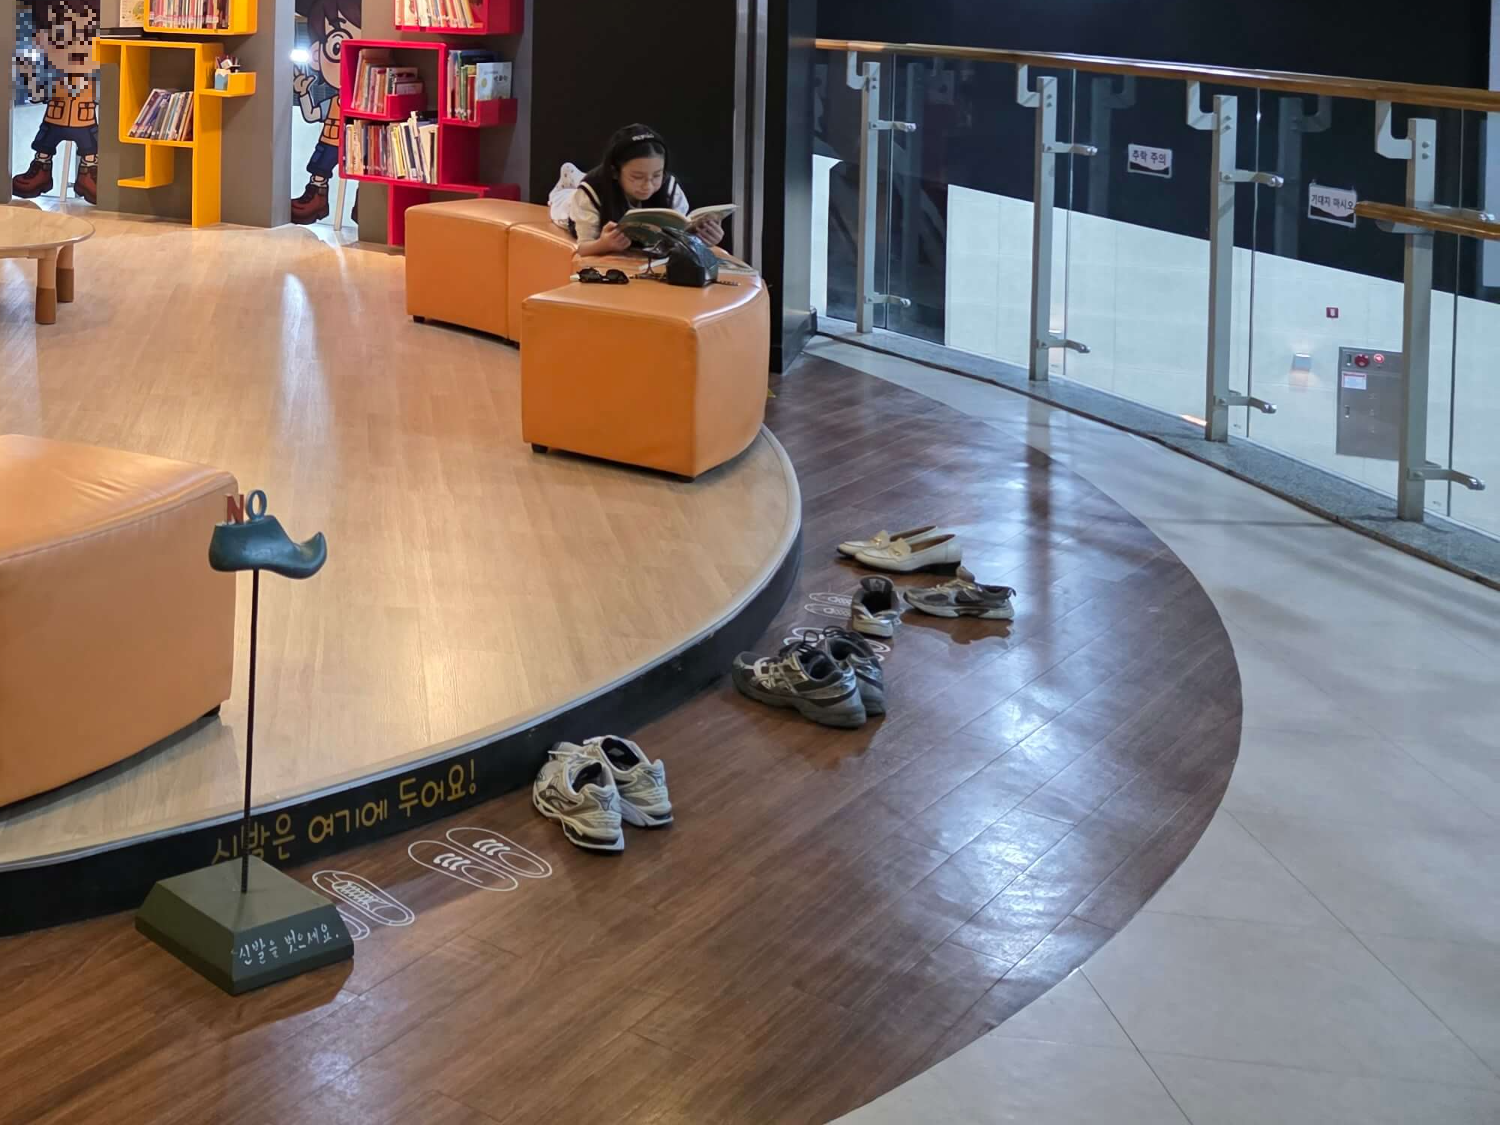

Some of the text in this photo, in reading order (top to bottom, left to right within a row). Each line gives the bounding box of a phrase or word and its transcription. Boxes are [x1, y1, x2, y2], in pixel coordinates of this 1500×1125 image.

[1132, 149, 1166, 166] 추락 주의
[1311, 194, 1331, 207] 기대지
[225, 489, 267, 524] NO
[308, 799, 388, 843] 여기에
[399, 759, 477, 817] 두어요!
